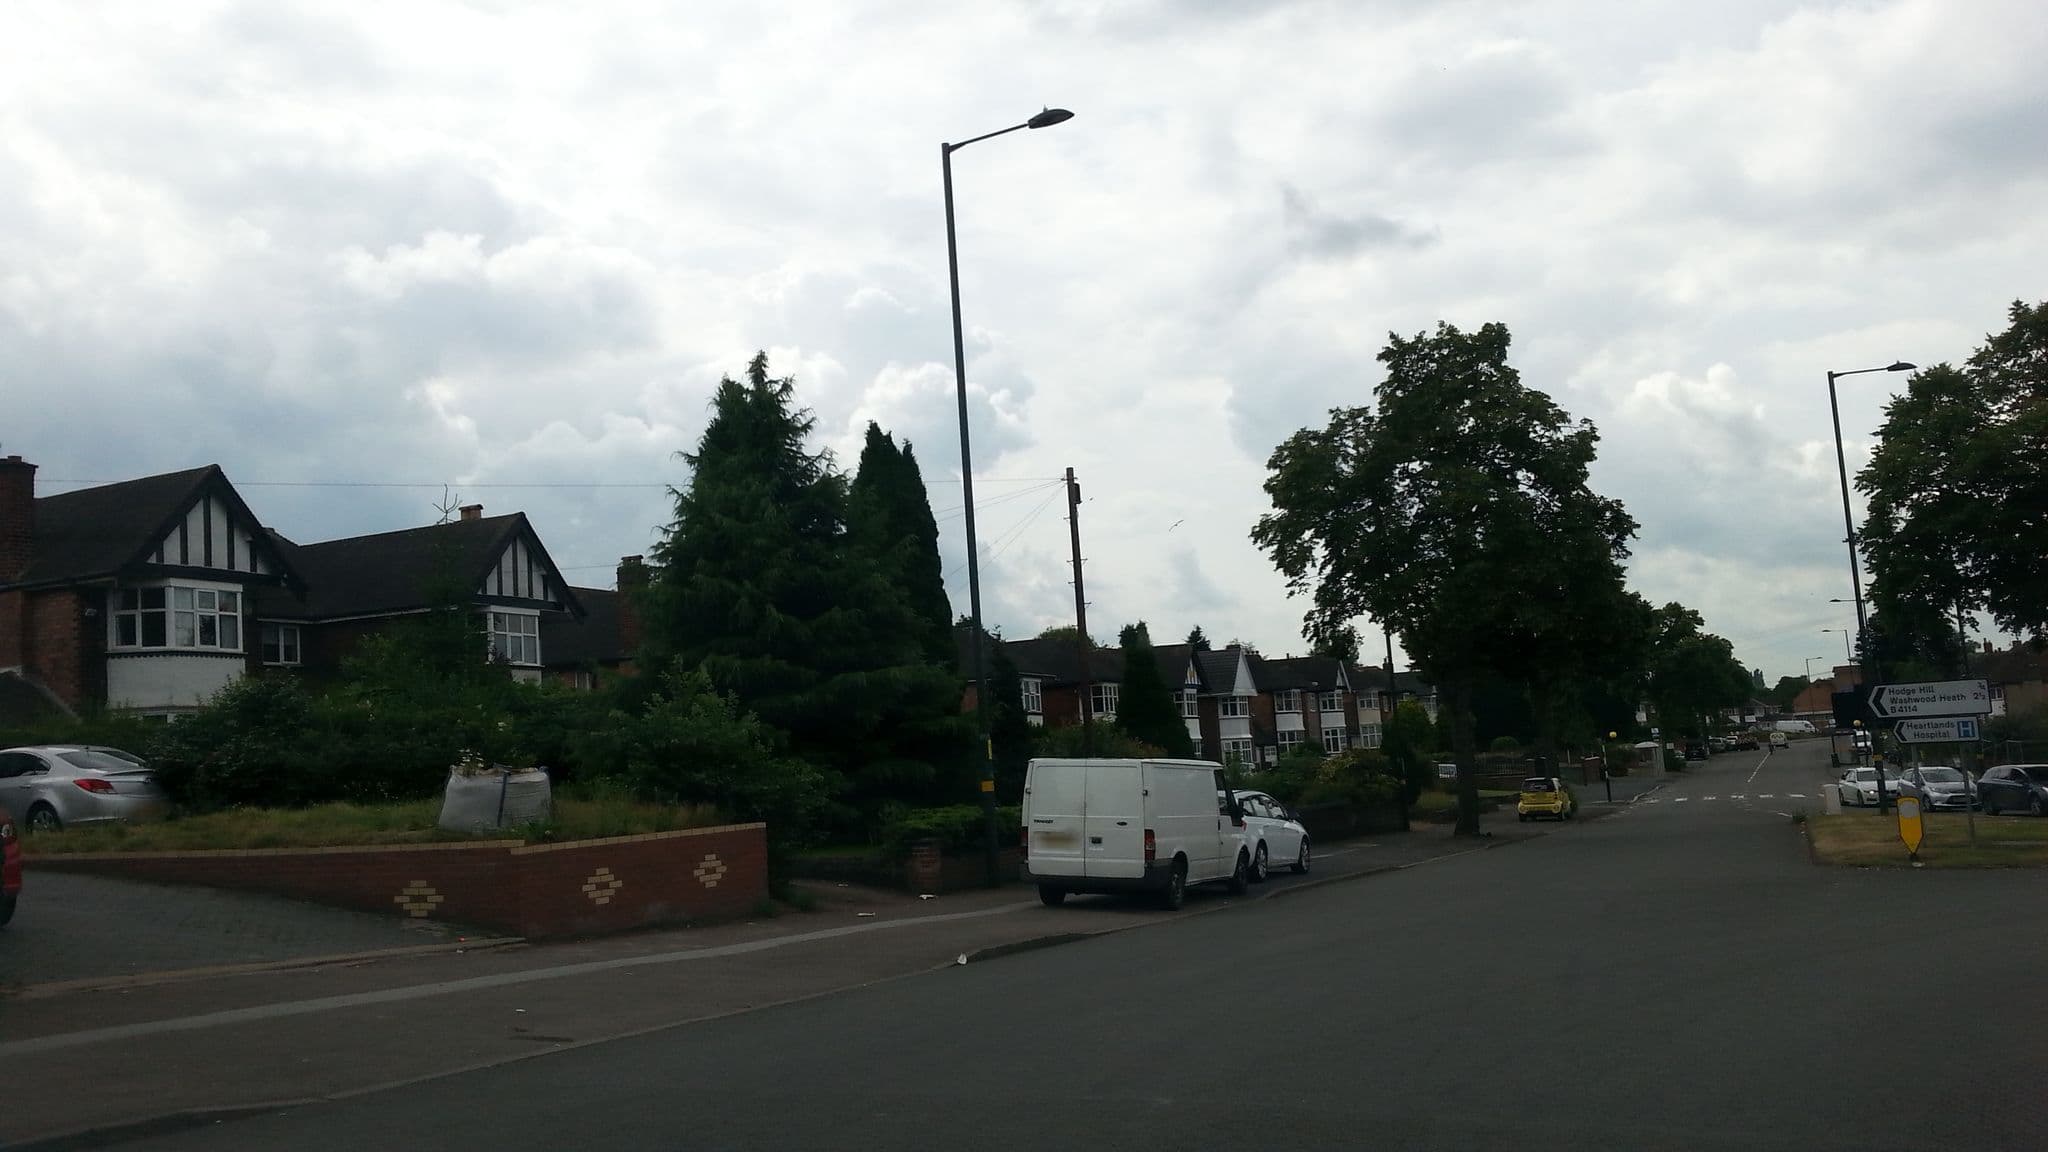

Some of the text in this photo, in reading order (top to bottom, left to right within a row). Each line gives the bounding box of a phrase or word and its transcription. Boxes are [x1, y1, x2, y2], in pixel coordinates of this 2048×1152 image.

[1888, 687, 1916, 696] Hodge
[1919, 685, 1935, 694] Hill
[1889, 695, 1937, 704] Washwood
[1939, 693, 1967, 702] Heath
[1906, 720, 1955, 730] Heartlands
[1913, 730, 1951, 740] Hospital
